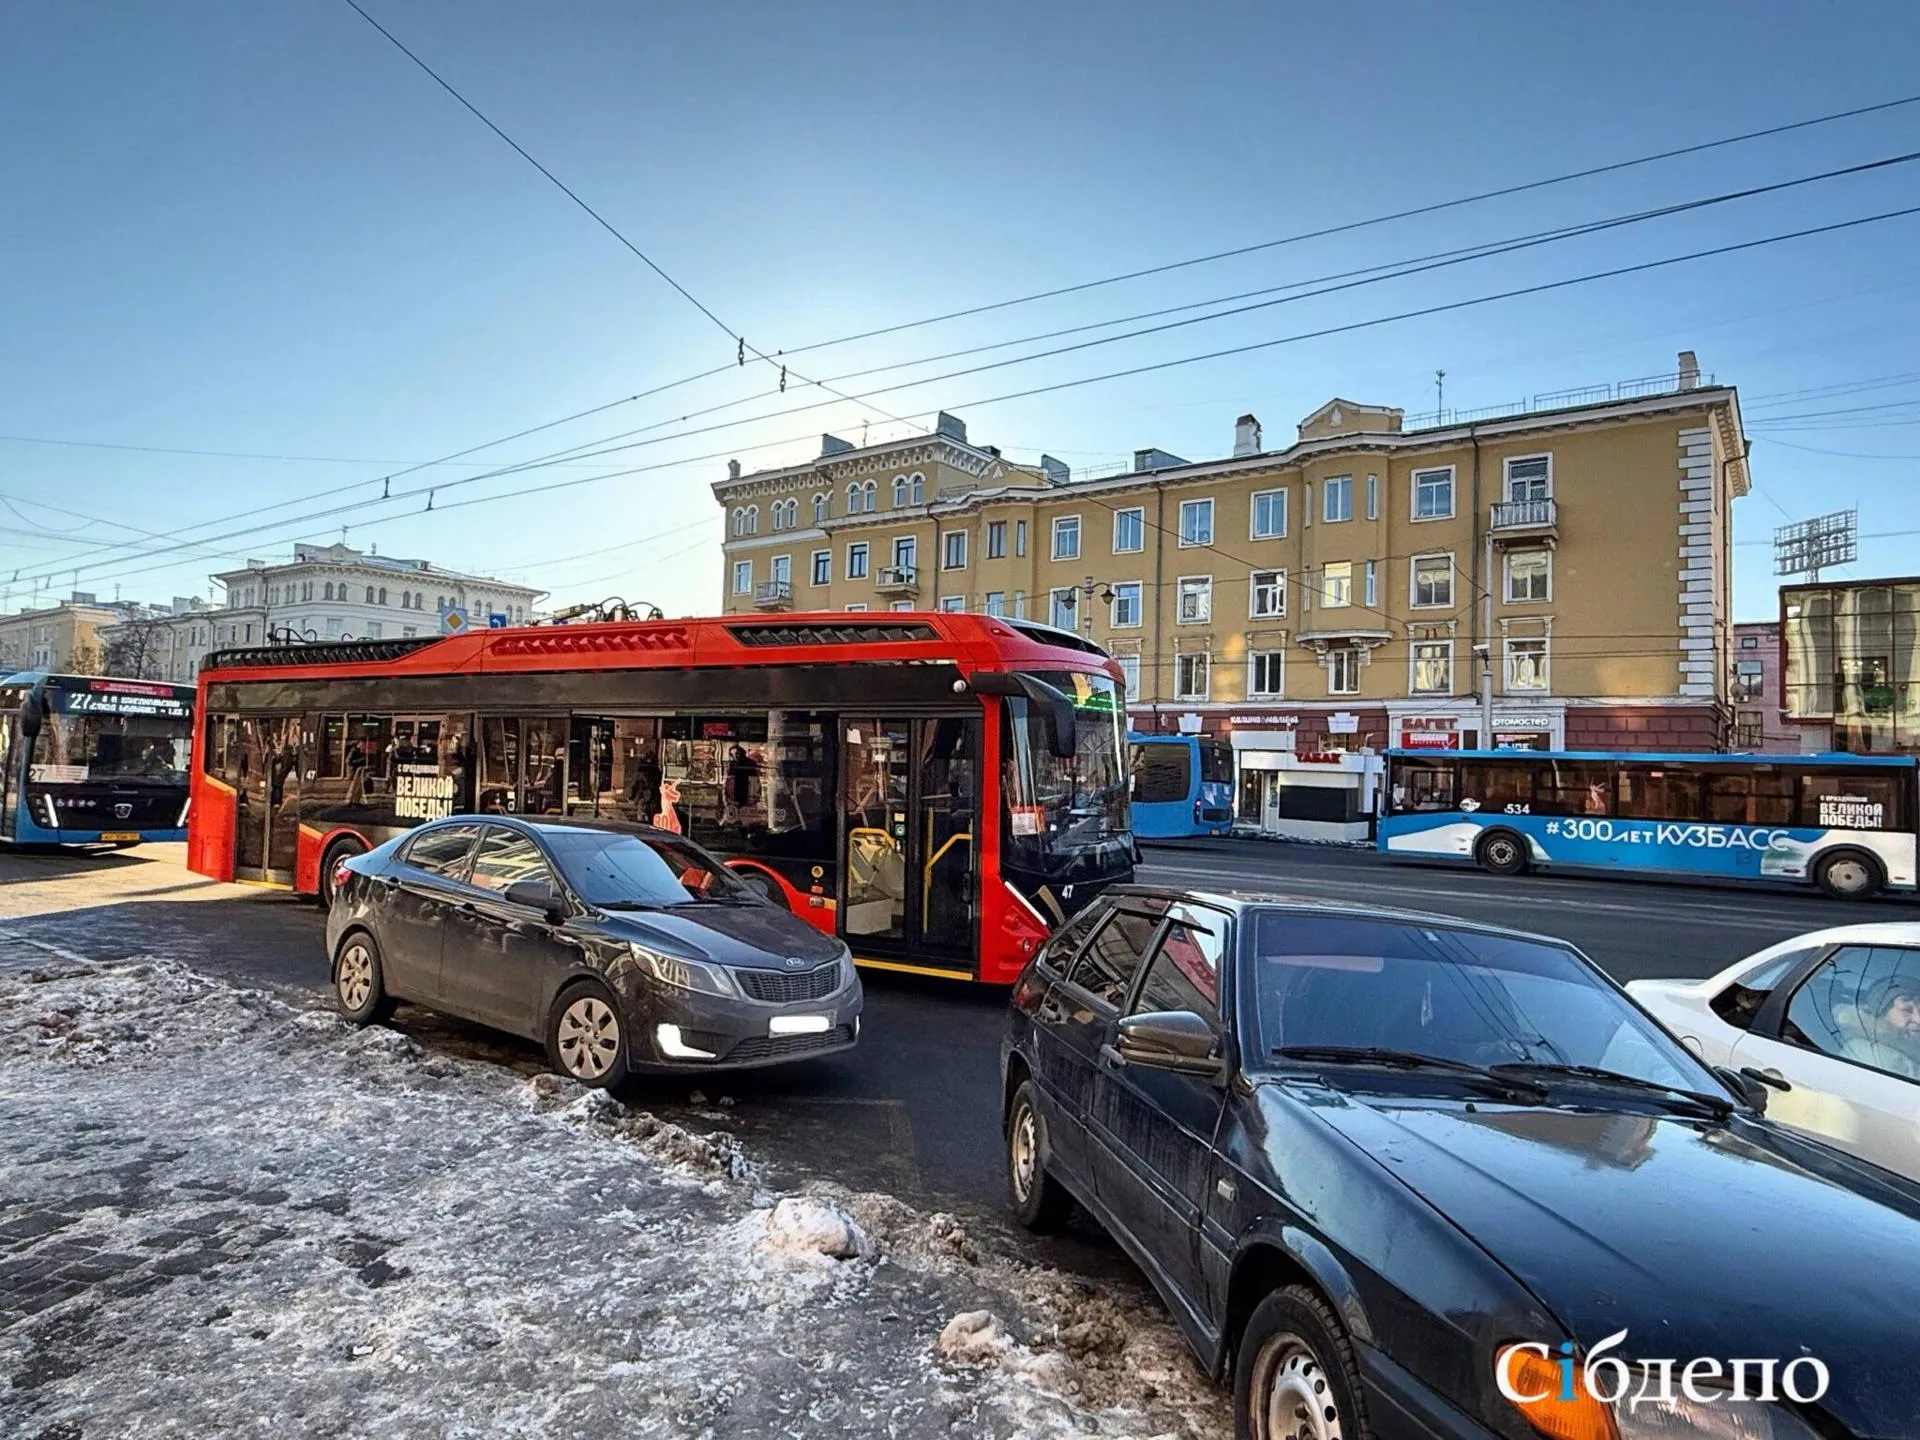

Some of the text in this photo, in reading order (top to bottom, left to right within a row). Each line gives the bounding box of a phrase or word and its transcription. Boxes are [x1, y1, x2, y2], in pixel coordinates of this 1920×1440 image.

[1401, 717, 1458, 730] БАГЕТ
[1295, 752, 1342, 764] ТАБАК
[396, 776, 454, 799] ВЕЛИКОЙ
[395, 797, 453, 822] ПОБЕДЫ!
[1506, 803, 1530, 814] 534
[1820, 802, 1883, 815] ВЕЛИКОЙ
[1819, 814, 1883, 828] ПОБЕДЫ!
[1061, 884, 1074, 899] 47
